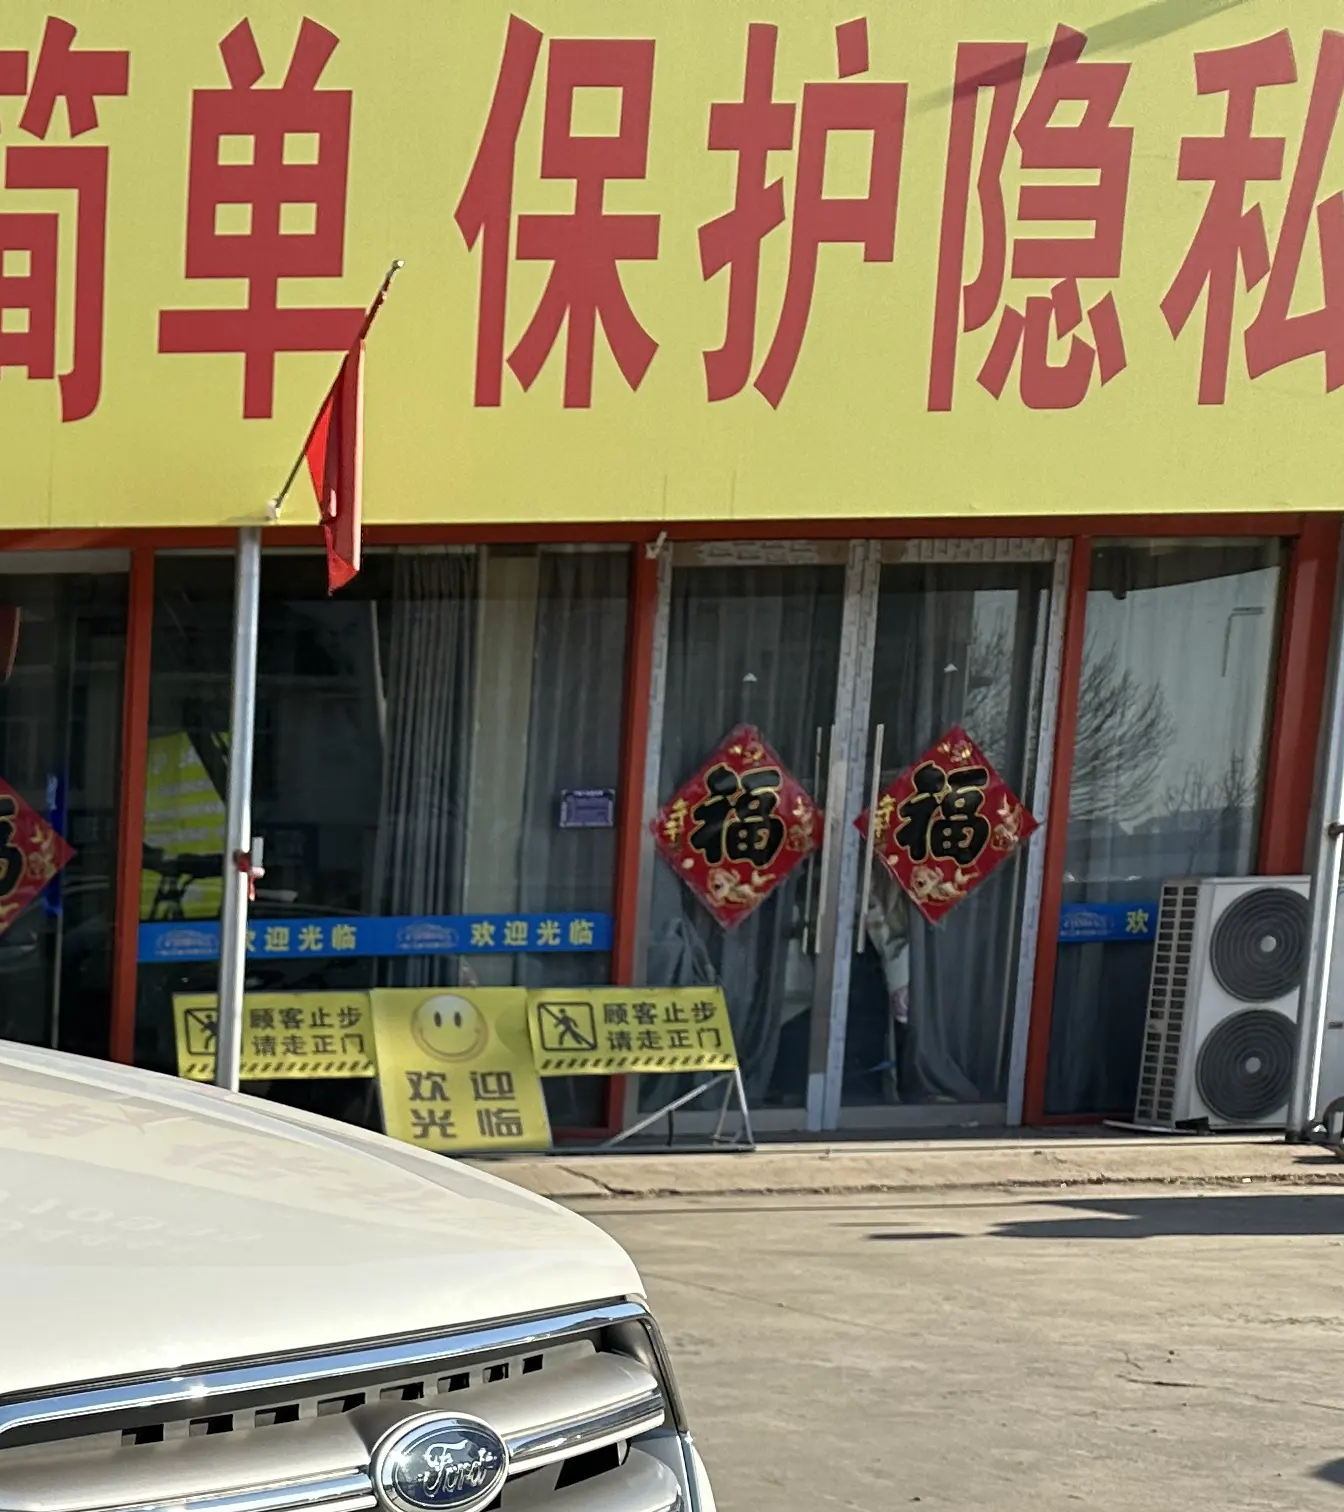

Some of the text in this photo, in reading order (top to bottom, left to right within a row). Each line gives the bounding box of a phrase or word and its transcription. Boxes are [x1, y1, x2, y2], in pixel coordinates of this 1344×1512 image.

[454, 14, 1344, 413] 保护隐私
[687, 761, 788, 869] 福
[893, 759, 992, 869] 福
[469, 919, 596, 948] 欢迎光临
[1124, 908, 1150, 934] 欢
[248, 1006, 363, 1031] 顾客止步
[602, 1000, 718, 1026] 顾客止步
[251, 1033, 366, 1058] 请走正门
[606, 1027, 723, 1052] 请走正门
[404, 1069, 518, 1103] 欢迎
[409, 1107, 524, 1140] 光临
[417, 1439, 498, 1498] Ford
